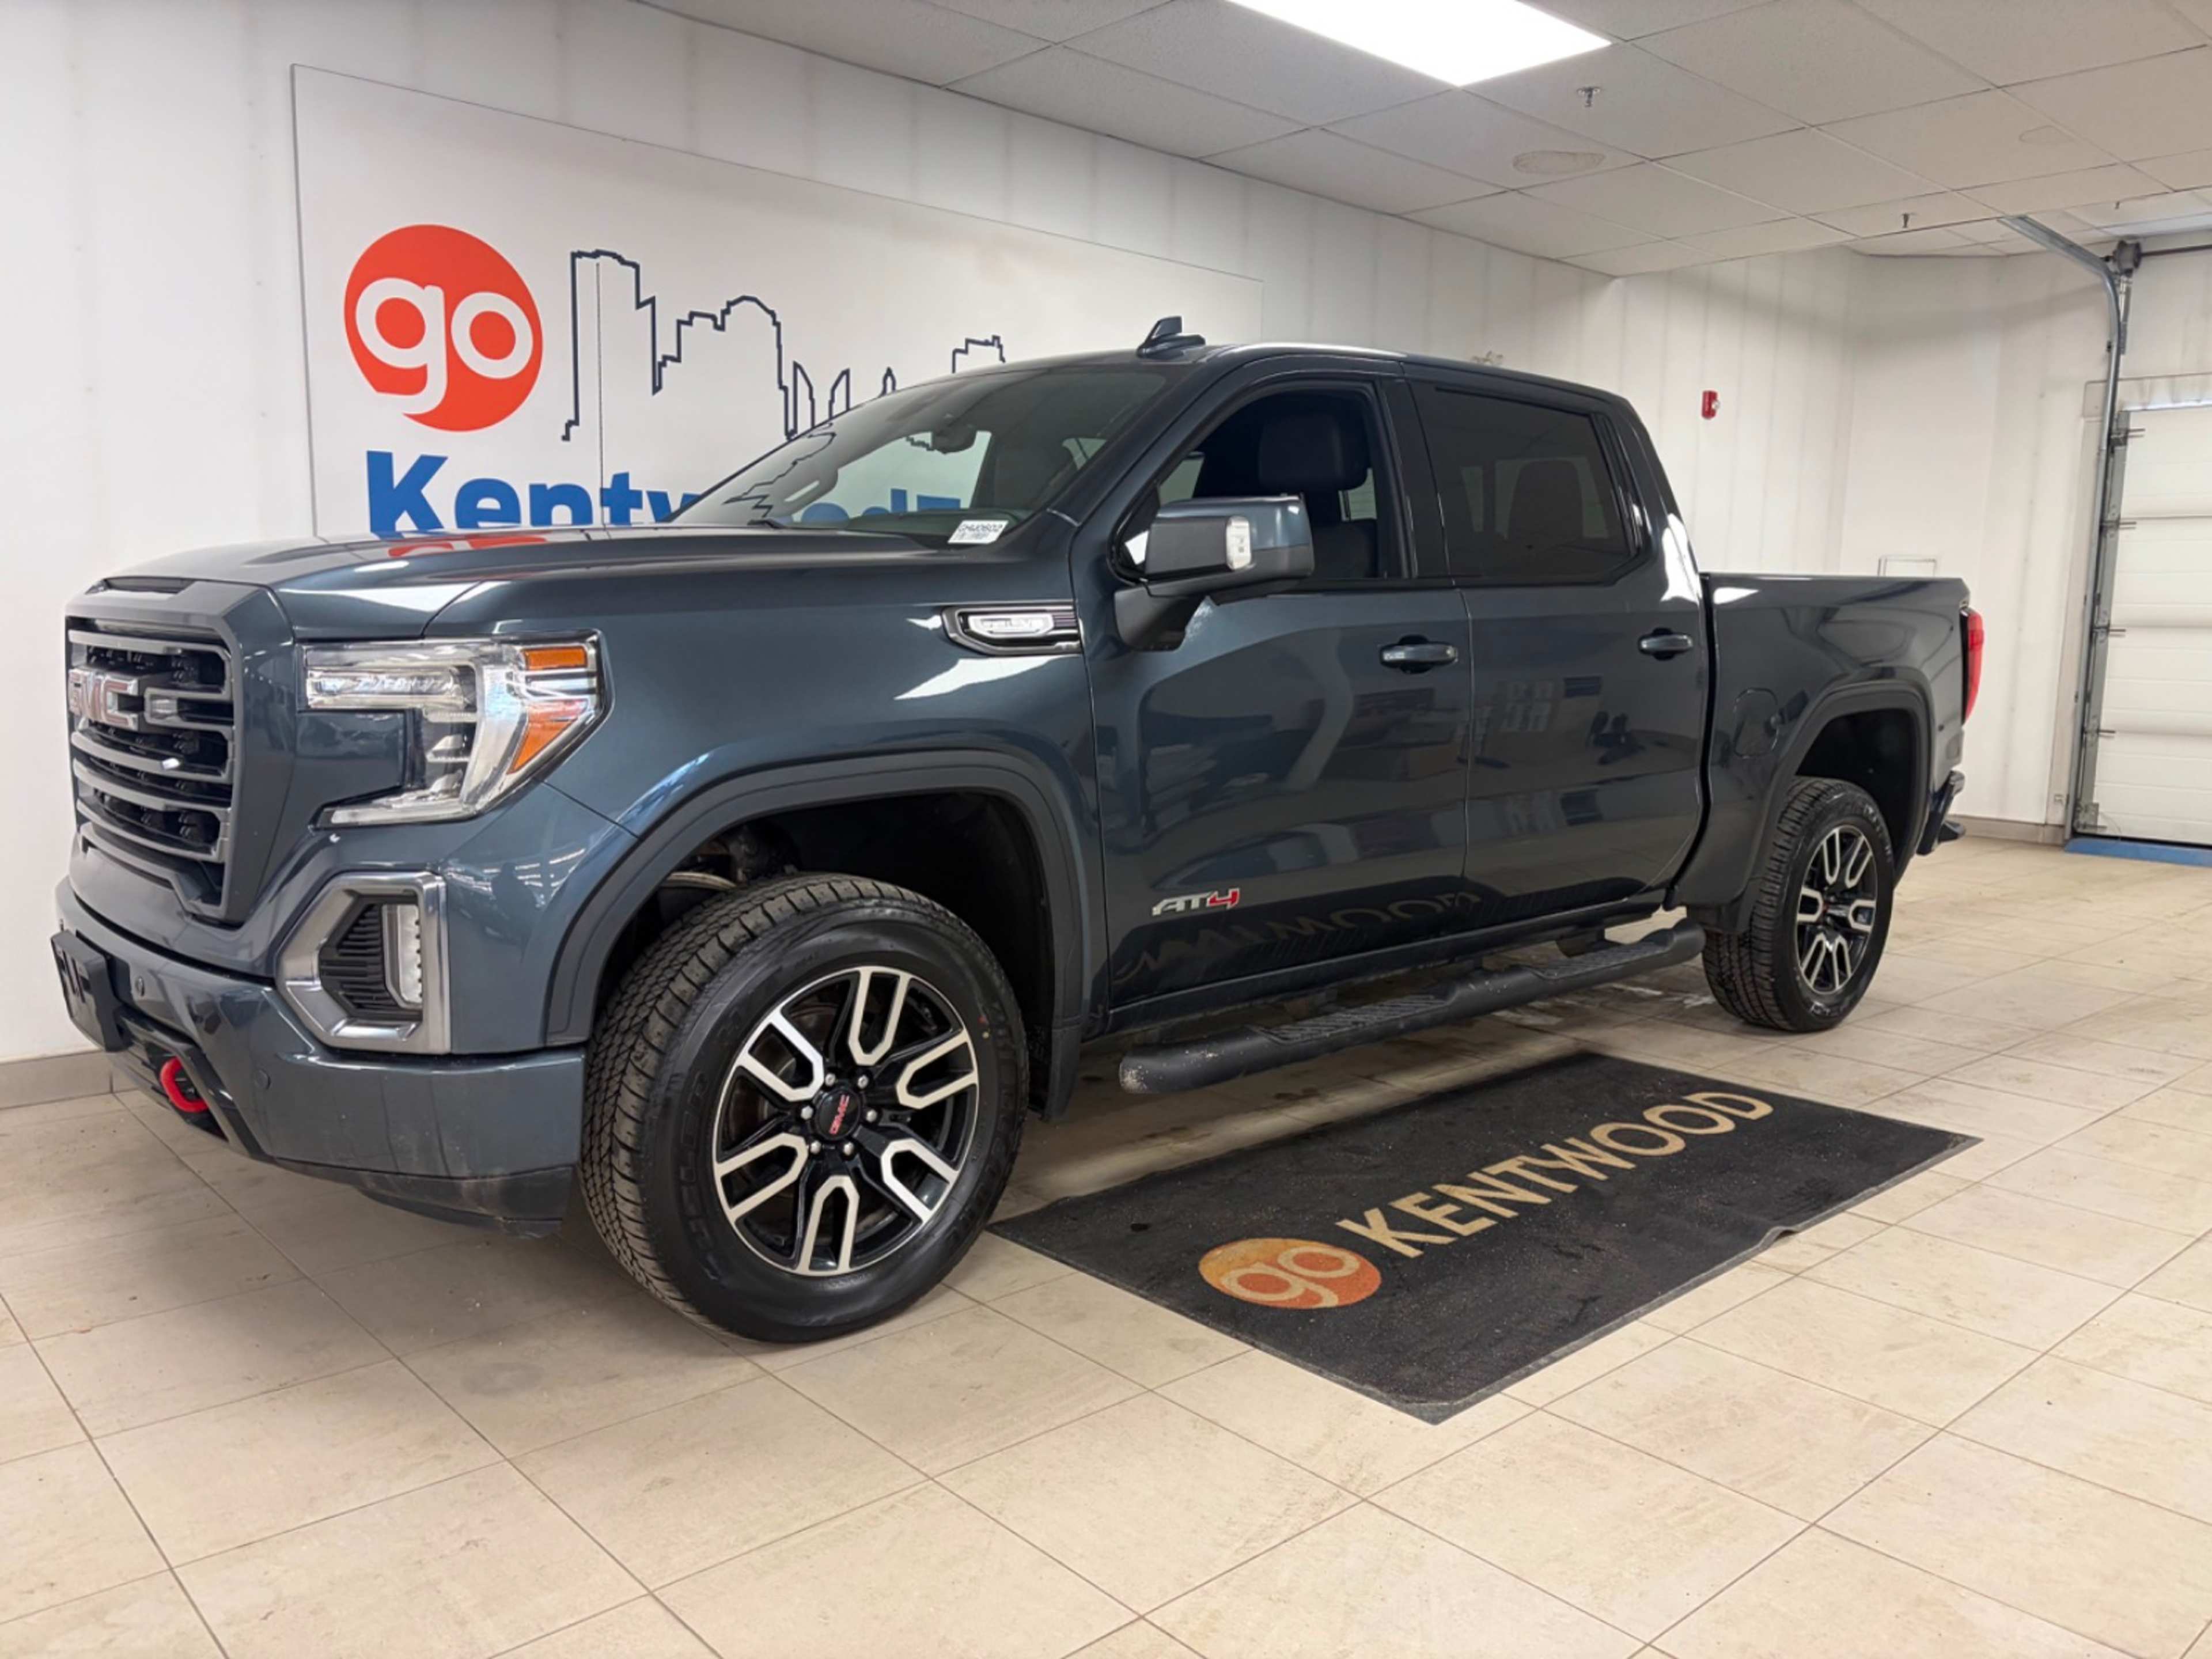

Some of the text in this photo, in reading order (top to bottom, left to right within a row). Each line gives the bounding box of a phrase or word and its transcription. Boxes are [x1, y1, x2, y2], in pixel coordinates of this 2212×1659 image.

[355, 277, 533, 415] go
[1152, 888, 1240, 916] AT4
[1219, 1091, 1774, 1308] go KENTWOOD
